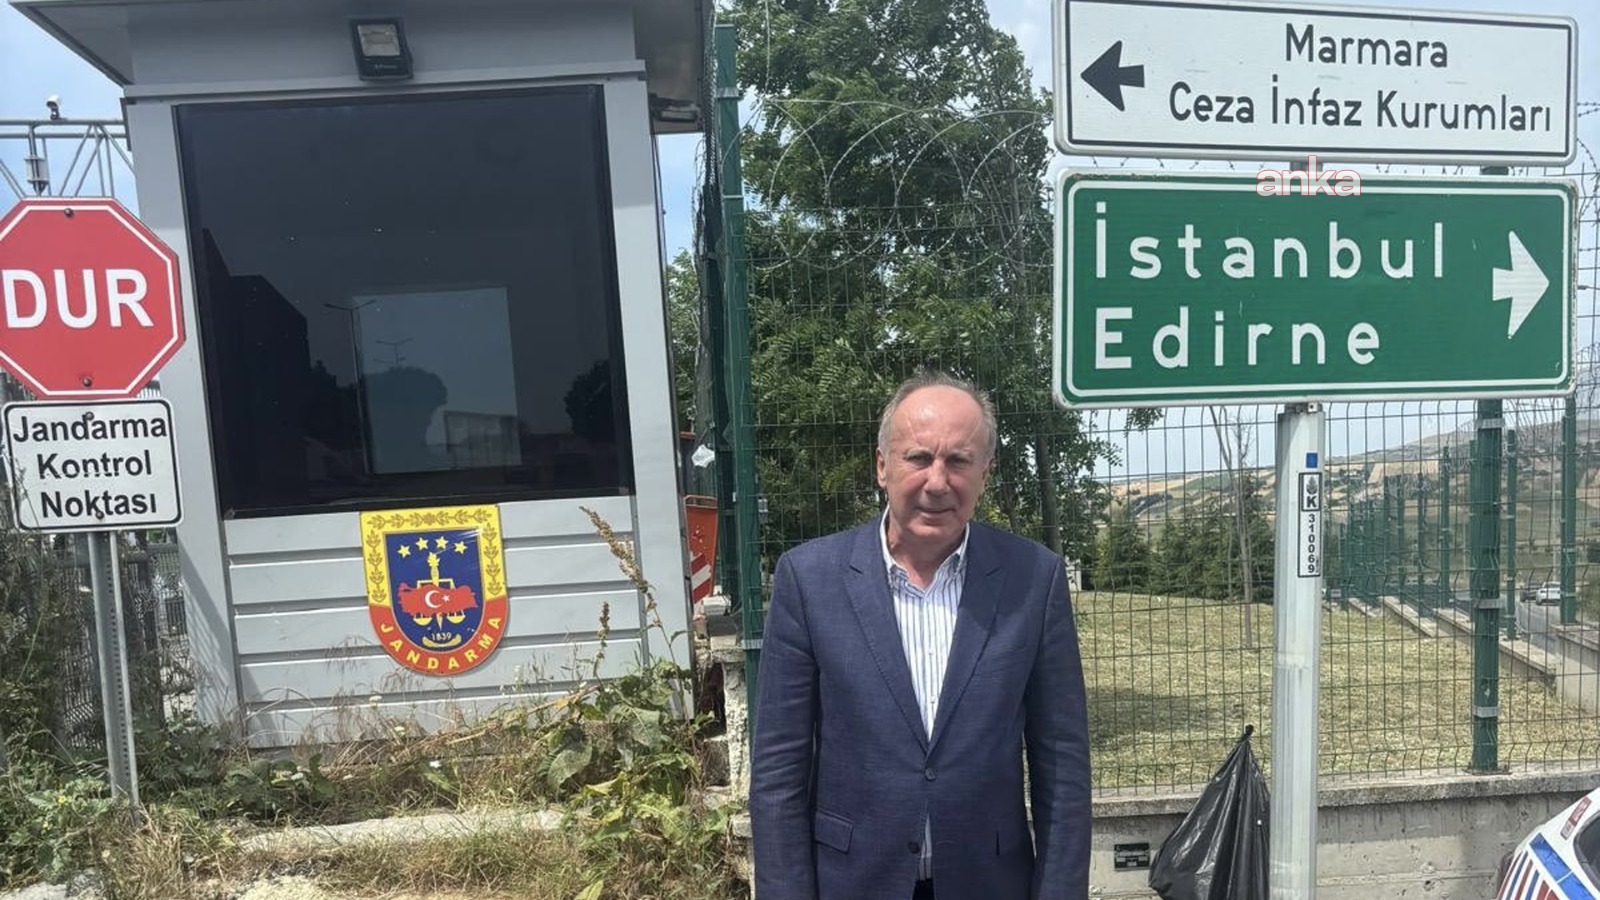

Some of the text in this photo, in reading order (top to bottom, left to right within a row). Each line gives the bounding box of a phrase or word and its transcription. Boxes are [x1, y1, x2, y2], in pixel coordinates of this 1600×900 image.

[1285, 23, 1448, 67] Marmara
[1169, 74, 1551, 132] Ceza İnfaz Kurumları
[1096, 202, 1443, 278] İstanbul
[2, 269, 154, 328] DUR
[1094, 306, 1381, 370] Edirne
[13, 415, 167, 442] Jandarma
[37, 450, 151, 479] Kontrol
[41, 490, 157, 520] Noktası
[1306, 496, 1317, 508] K
[1307, 514, 1316, 573] 310069
[381, 617, 501, 669] JANDARMA
[430, 632, 453, 641] 1839
